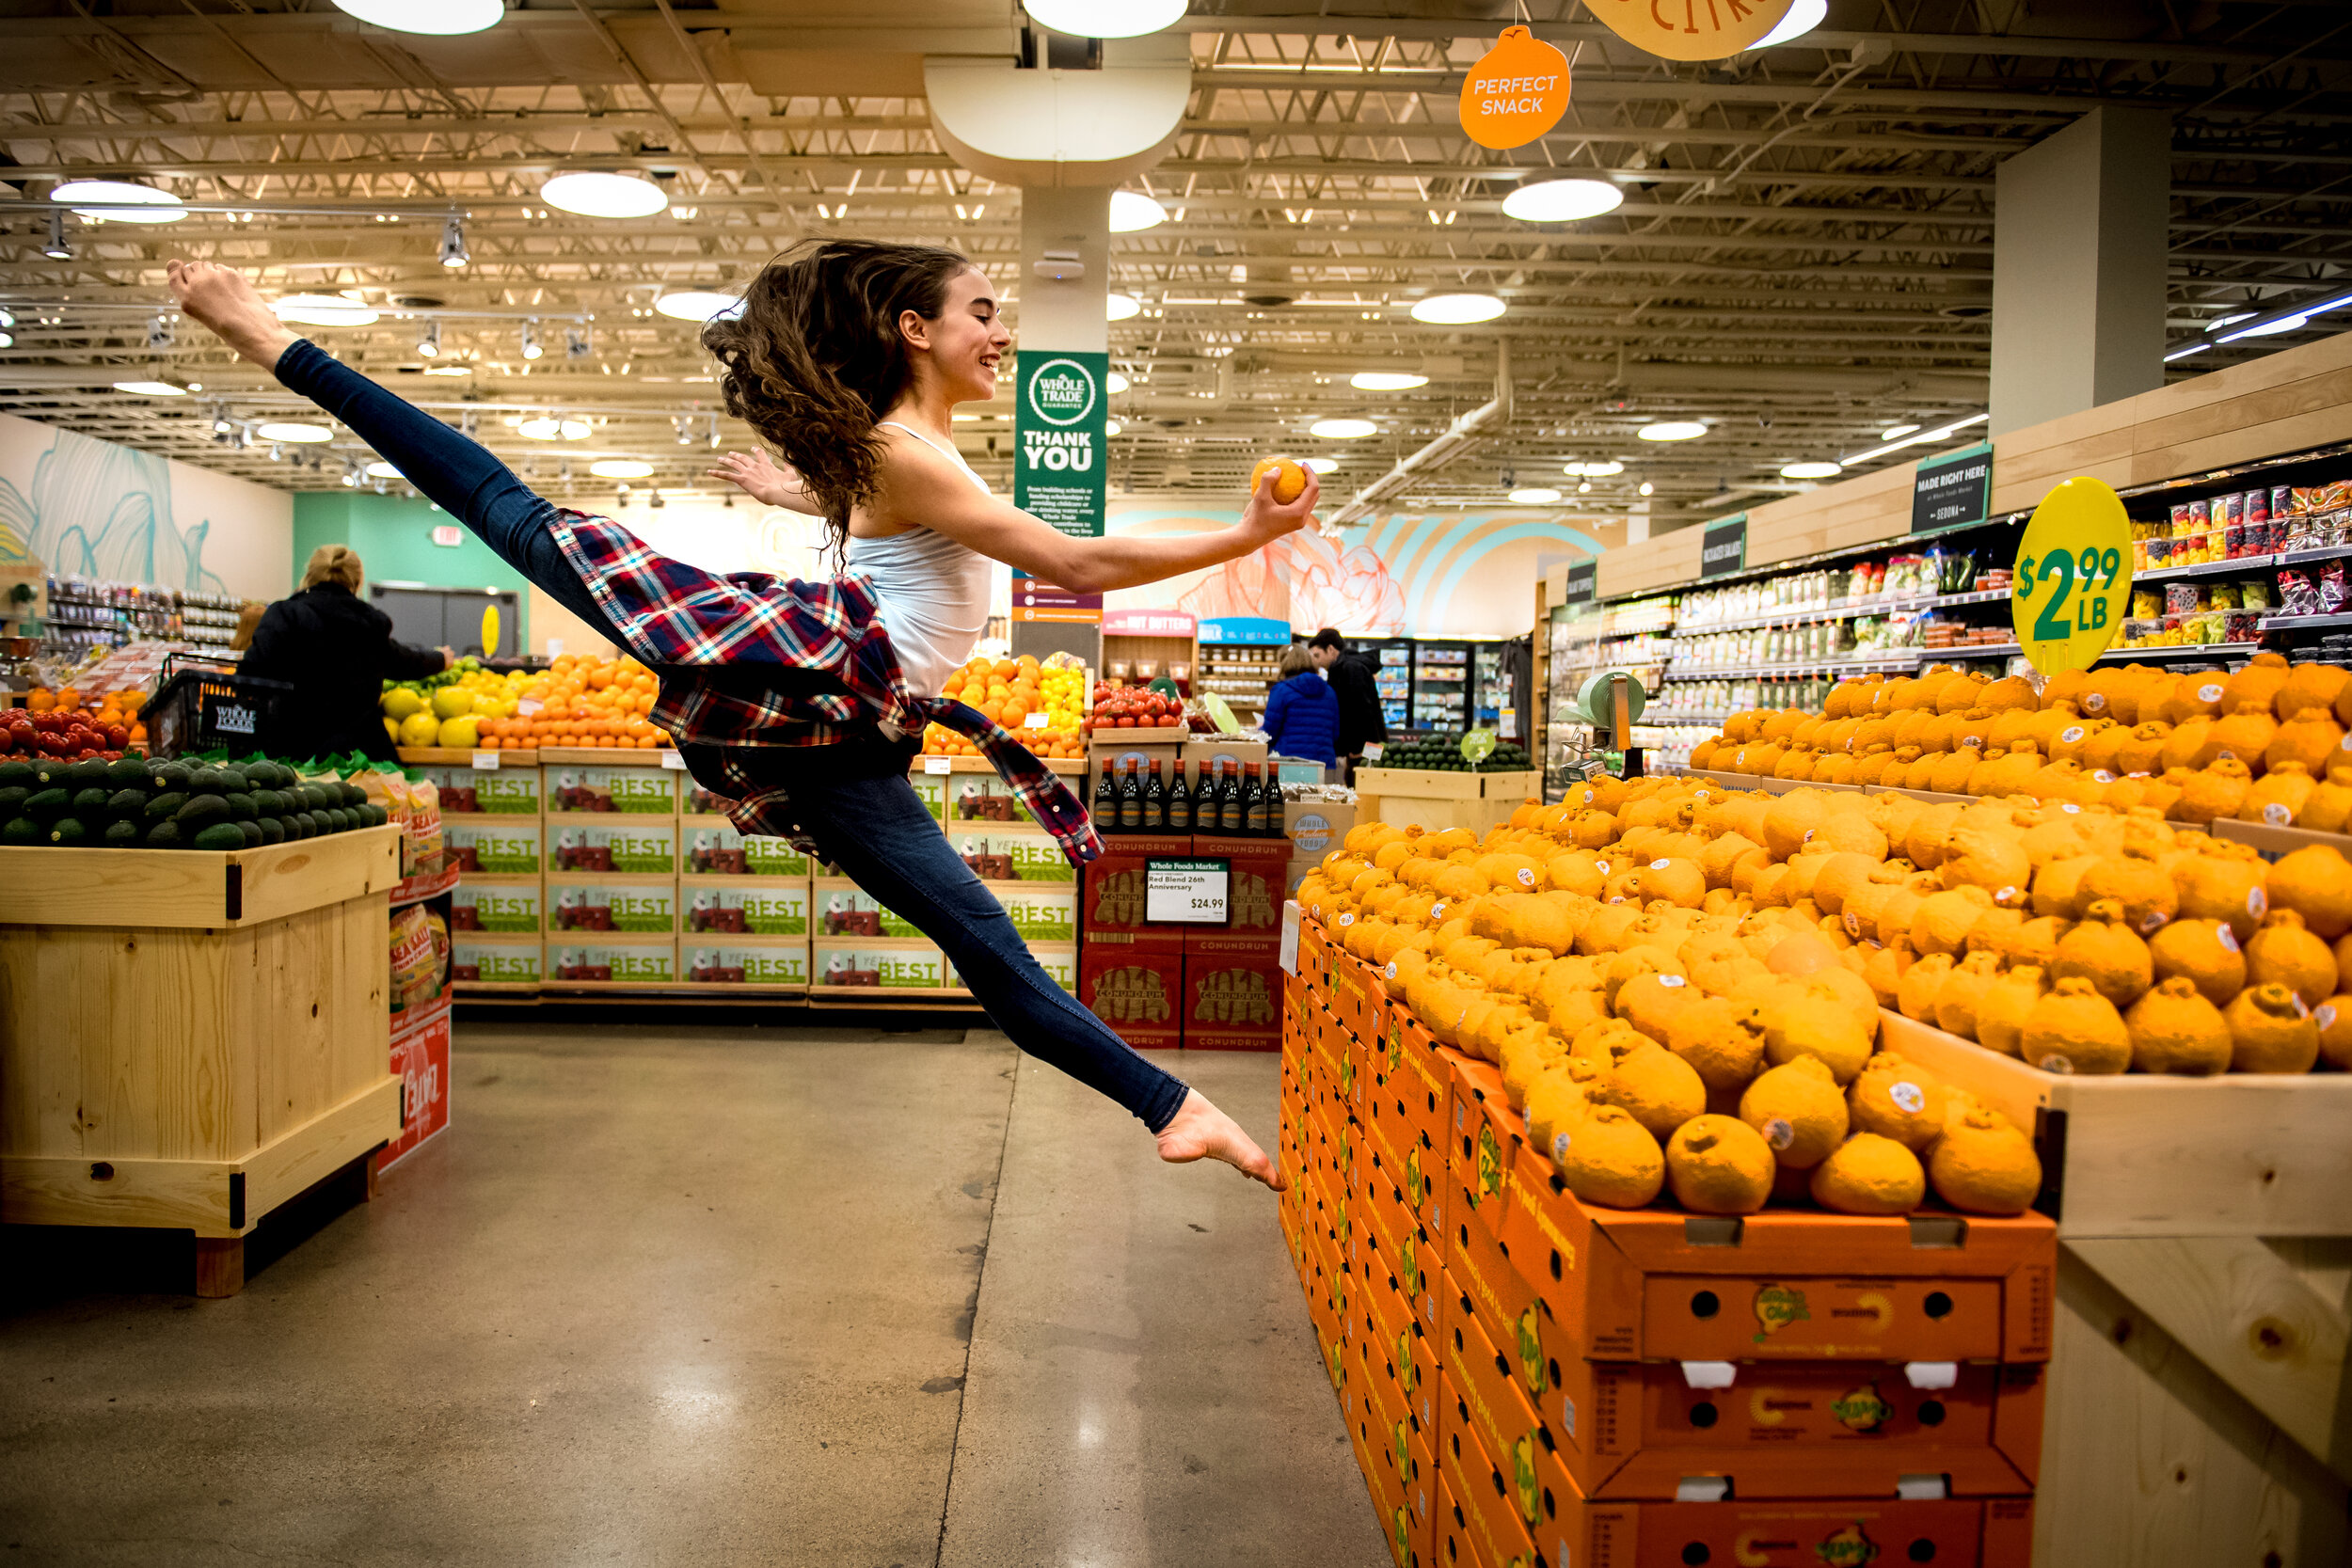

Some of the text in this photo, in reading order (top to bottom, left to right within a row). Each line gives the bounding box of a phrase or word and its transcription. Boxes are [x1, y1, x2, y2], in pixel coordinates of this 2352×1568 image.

[1474, 74, 1559, 95] PERFECT
[1480, 97, 1544, 116] SNACK
[1039, 378, 1086, 391] WHOLE
[1041, 390, 1083, 403] TRADE
[1023, 431, 1091, 448] THANK
[1024, 447, 1092, 471] YOU
[1917, 465, 1986, 492] MADE RIGHT HERE
[1936, 505, 1959, 521] SEDONA
[2077, 596, 2107, 631] LB
[215, 705, 257, 721] WHOLE
[217, 717, 254, 730] FOODS
[474, 779, 534, 798] BEST
[611, 779, 670, 798] BEST
[475, 839, 535, 857] BEST
[611, 839, 670, 857] BEST
[1107, 842, 1176, 852] CONUNDRUM
[1209, 845, 1278, 855] CONUNDRUM
[1150, 862, 1173, 870] Whole
[475, 898, 535, 916] BEST
[611, 898, 670, 916] BEST
[743, 900, 803, 918] BEST
[1191, 898, 1224, 909] $24.99
[1010, 907, 1070, 924] BEST
[1200, 942, 1269, 951] CONUNDRUM
[479, 958, 537, 975] BEST
[611, 958, 670, 975] BEST
[743, 959, 803, 976] BEST
[878, 962, 938, 980] BEST
[1098, 990, 1164, 999] CONUNDRUM
[1201, 992, 1269, 1001] CONUNDRUM
[1200, 1037, 1267, 1047] CONUNDRUM
